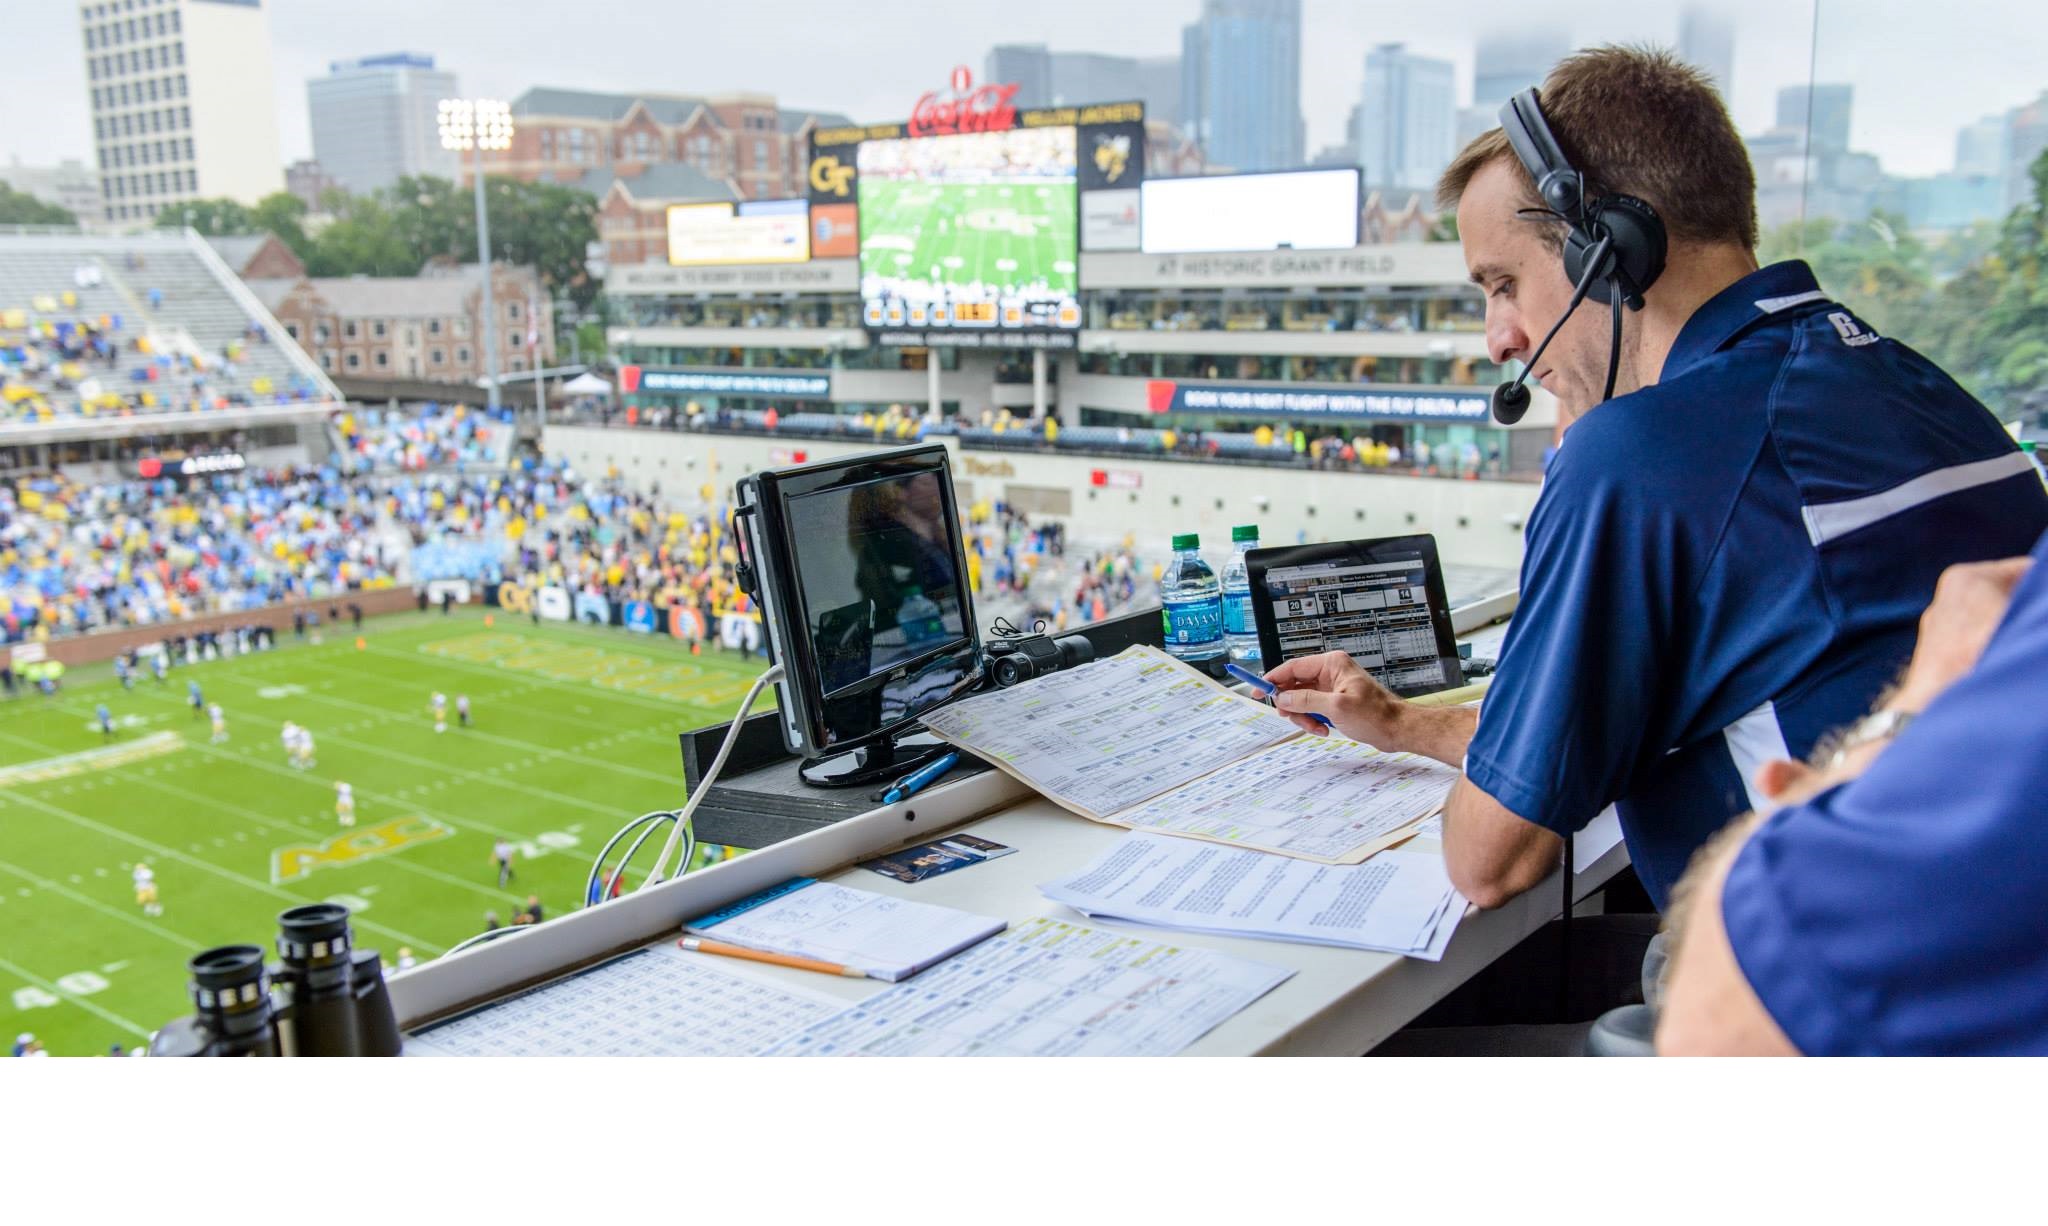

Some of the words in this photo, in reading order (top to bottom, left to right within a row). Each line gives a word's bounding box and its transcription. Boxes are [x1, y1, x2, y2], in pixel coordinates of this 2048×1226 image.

[1157, 259, 1176, 276] AT
[1183, 257, 1265, 277] HISTORIC
[1270, 256, 1334, 275] GRANT
[1340, 255, 1396, 275] FIELD
[1185, 390, 1218, 407] BOOK
[1220, 391, 1251, 409] YOUR
[1285, 393, 1327, 412] FLIGHT
[1328, 395, 1365, 413] WITH
[1366, 395, 1390, 414] THE
[1414, 397, 1456, 416] DELTA
[1457, 398, 1487, 416] APP
[963, 457, 1014, 477] Tech
[1290, 602, 1300, 610] 20
